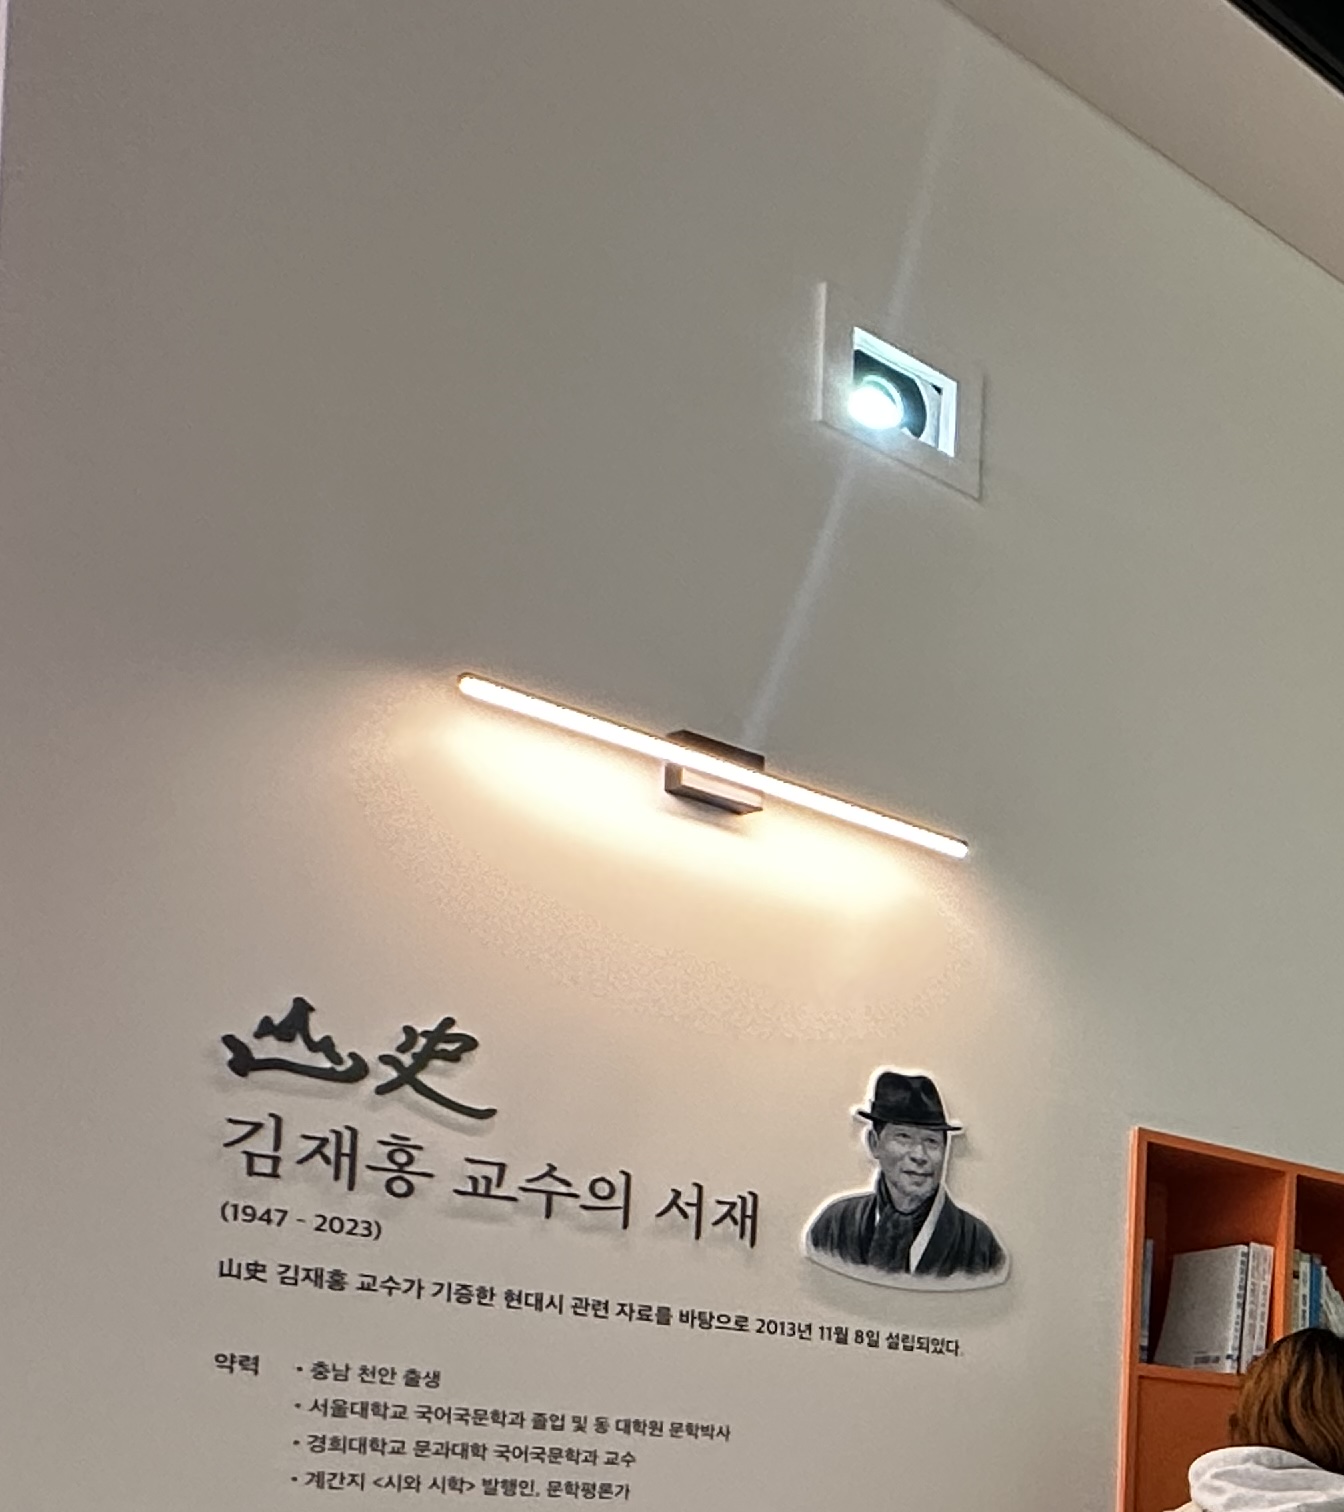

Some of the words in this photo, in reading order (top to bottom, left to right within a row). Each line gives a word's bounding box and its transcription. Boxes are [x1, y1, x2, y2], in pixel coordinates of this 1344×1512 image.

[223, 1113, 434, 1199] 김재홍
[453, 1149, 632, 1230] 교수의
[655, 1181, 760, 1248] 서재
[220, 1204, 288, 1229] (1947
[313, 1213, 382, 1241] 2023)
[219, 1258, 267, 1283] 山史
[277, 1264, 348, 1291] 김재홍
[356, 1274, 425, 1299] 교수가
[432, 1282, 496, 1307] 기증한
[505, 1289, 563, 1315] 현대시
[571, 1297, 609, 1319] 관련
[616, 1303, 673, 1325] 자료를
[679, 1309, 749, 1332] 바탕으로
[756, 1319, 811, 1341] 2013년
[819, 1326, 848, 1345] 11월
[854, 1330, 879, 1348] 8일
[886, 1333, 959, 1356] 설립되었다.
[215, 1353, 259, 1376] 약력
[310, 1361, 351, 1382] 충남
[358, 1365, 397, 1385] 천안
[403, 1369, 440, 1388] 출생
[309, 1398, 408, 1420] 서울대학교
[414, 1405, 526, 1429] 국어국문학과
[532, 1413, 565, 1431] 졸업
[572, 1416, 587, 1433] 및
[615, 1419, 663, 1437] 대학원
[669, 1422, 730, 1441] 문학박사
[307, 1435, 406, 1456] 경희대학교
[413, 1440, 488, 1461] 문과대학
[494, 1445, 598, 1466] 국어국문학과
[604, 1451, 636, 1467] 교수
[305, 1471, 365, 1491] 계간지
[373, 1474, 421, 1493] <시와
[428, 1476, 475, 1494] 시학>
[482, 1478, 540, 1497] 발행인,
[547, 1481, 630, 1500] 문학평론가
